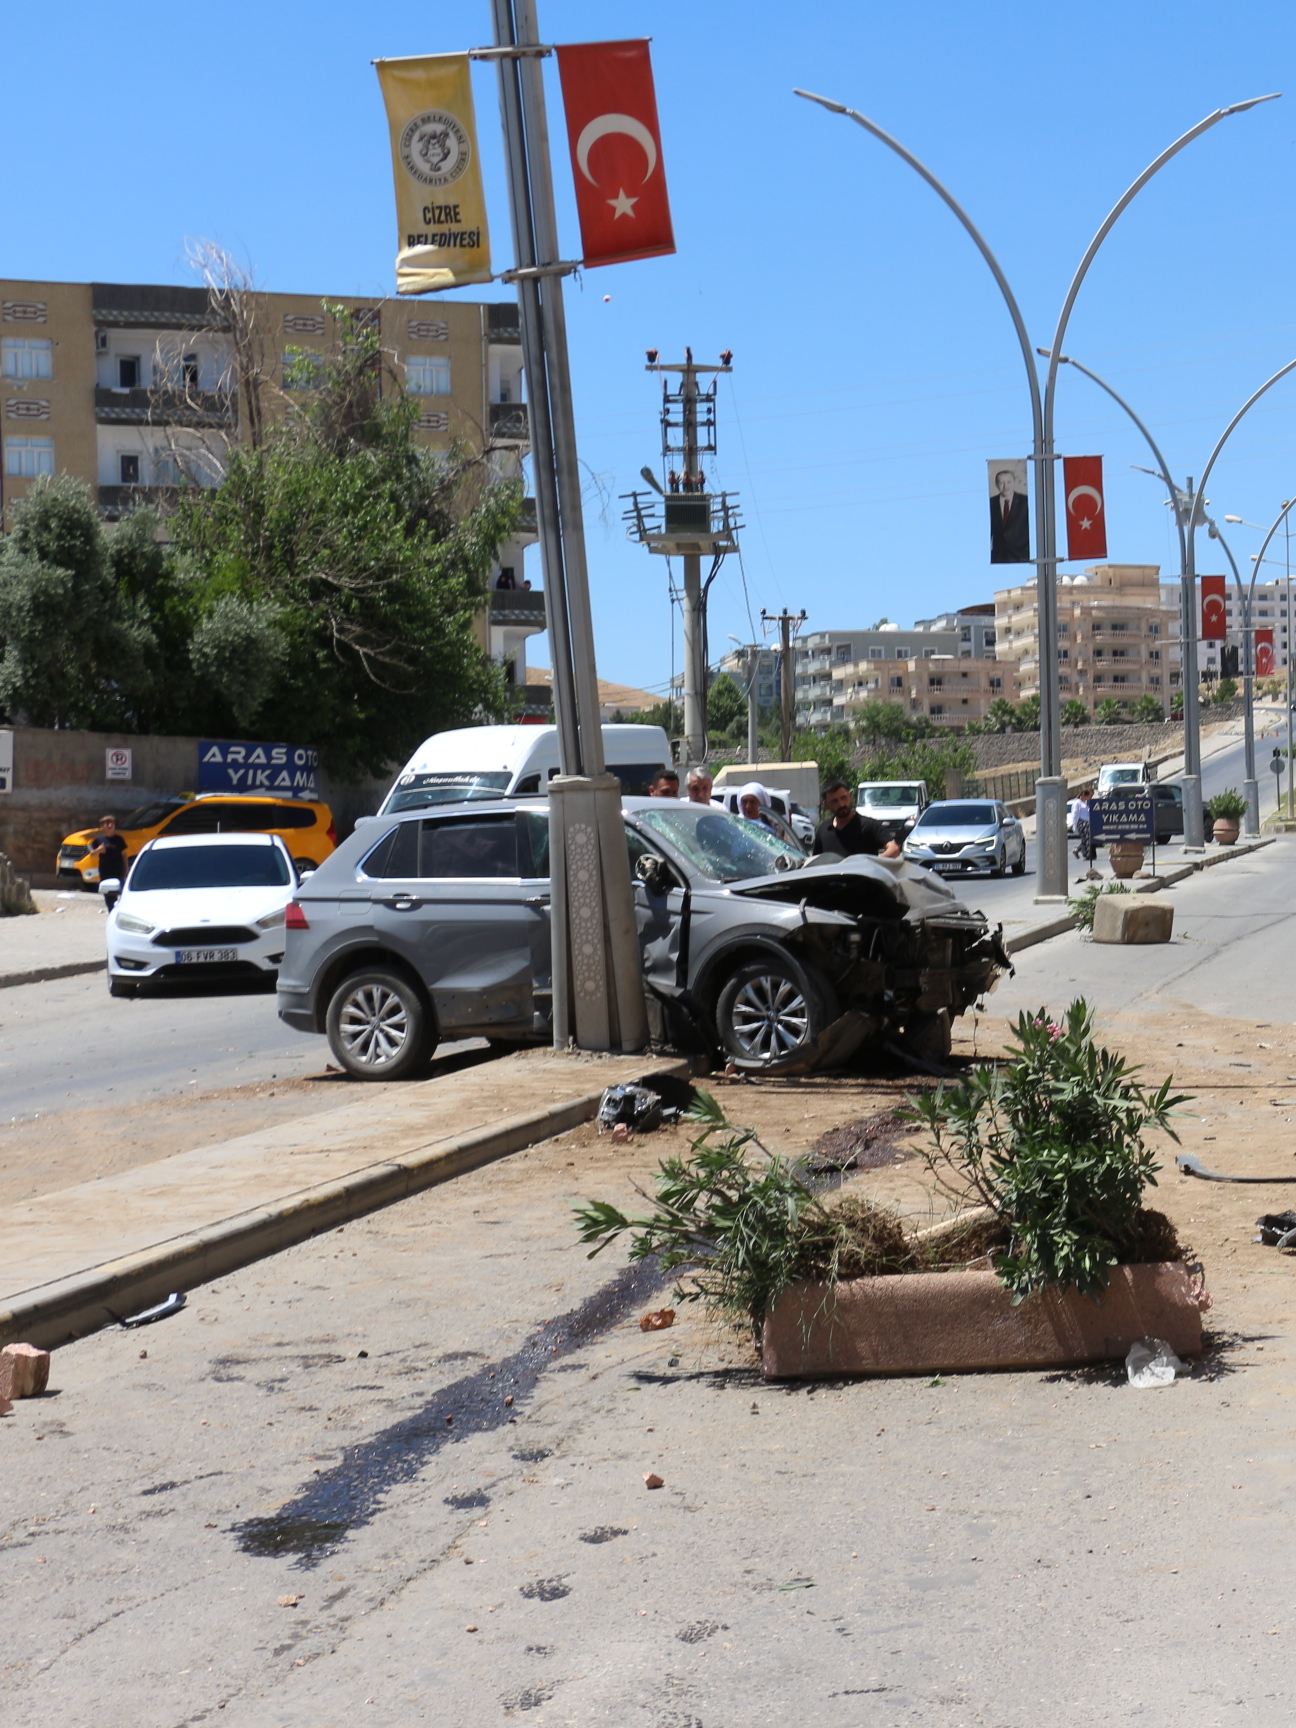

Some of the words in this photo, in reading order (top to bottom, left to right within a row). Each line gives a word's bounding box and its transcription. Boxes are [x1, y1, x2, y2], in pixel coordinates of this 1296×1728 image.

[423, 202, 462, 225] CİZRE
[407, 227, 480, 248] BELEDİYESİ
[202, 745, 288, 765] ARAS
[294, 748, 319, 768] OTO
[227, 768, 316, 789] YIKAMA
[1093, 801, 1125, 811] ARAS
[1128, 800, 1151, 810] OTO
[1102, 813, 1146, 823] YIKAMA
